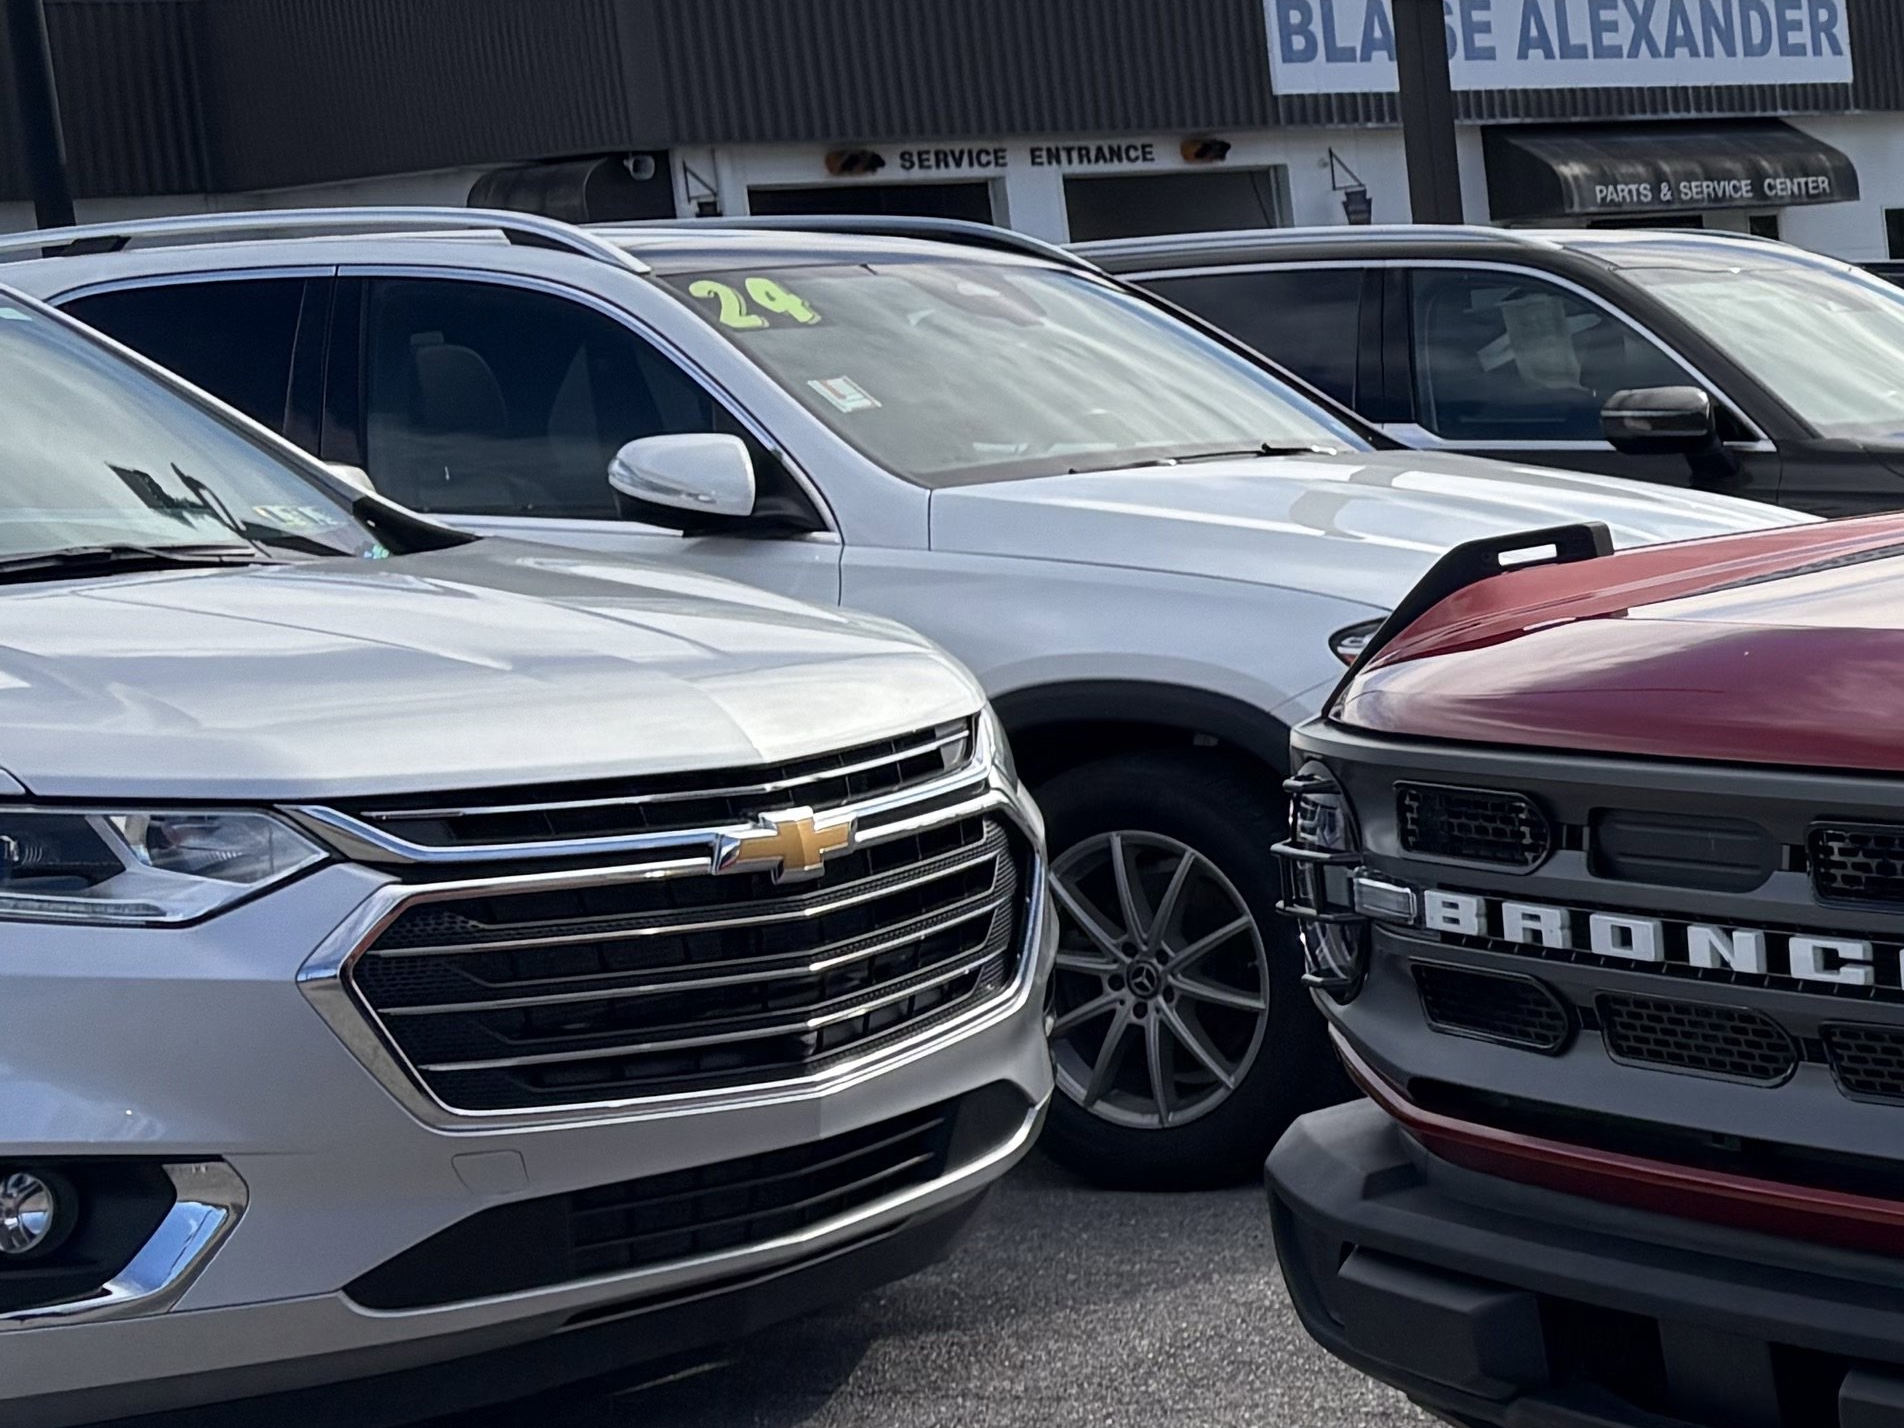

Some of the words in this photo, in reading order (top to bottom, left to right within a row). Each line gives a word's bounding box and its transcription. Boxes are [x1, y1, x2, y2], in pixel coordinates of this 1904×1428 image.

[899, 147, 1009, 171] SERVICE
[1030, 143, 1156, 167] ENTRANCE
[1595, 183, 1653, 204] PARTS
[1660, 182, 1673, 202] &
[1680, 179, 1753, 201] SERVICE
[1763, 176, 1831, 197] CENTER
